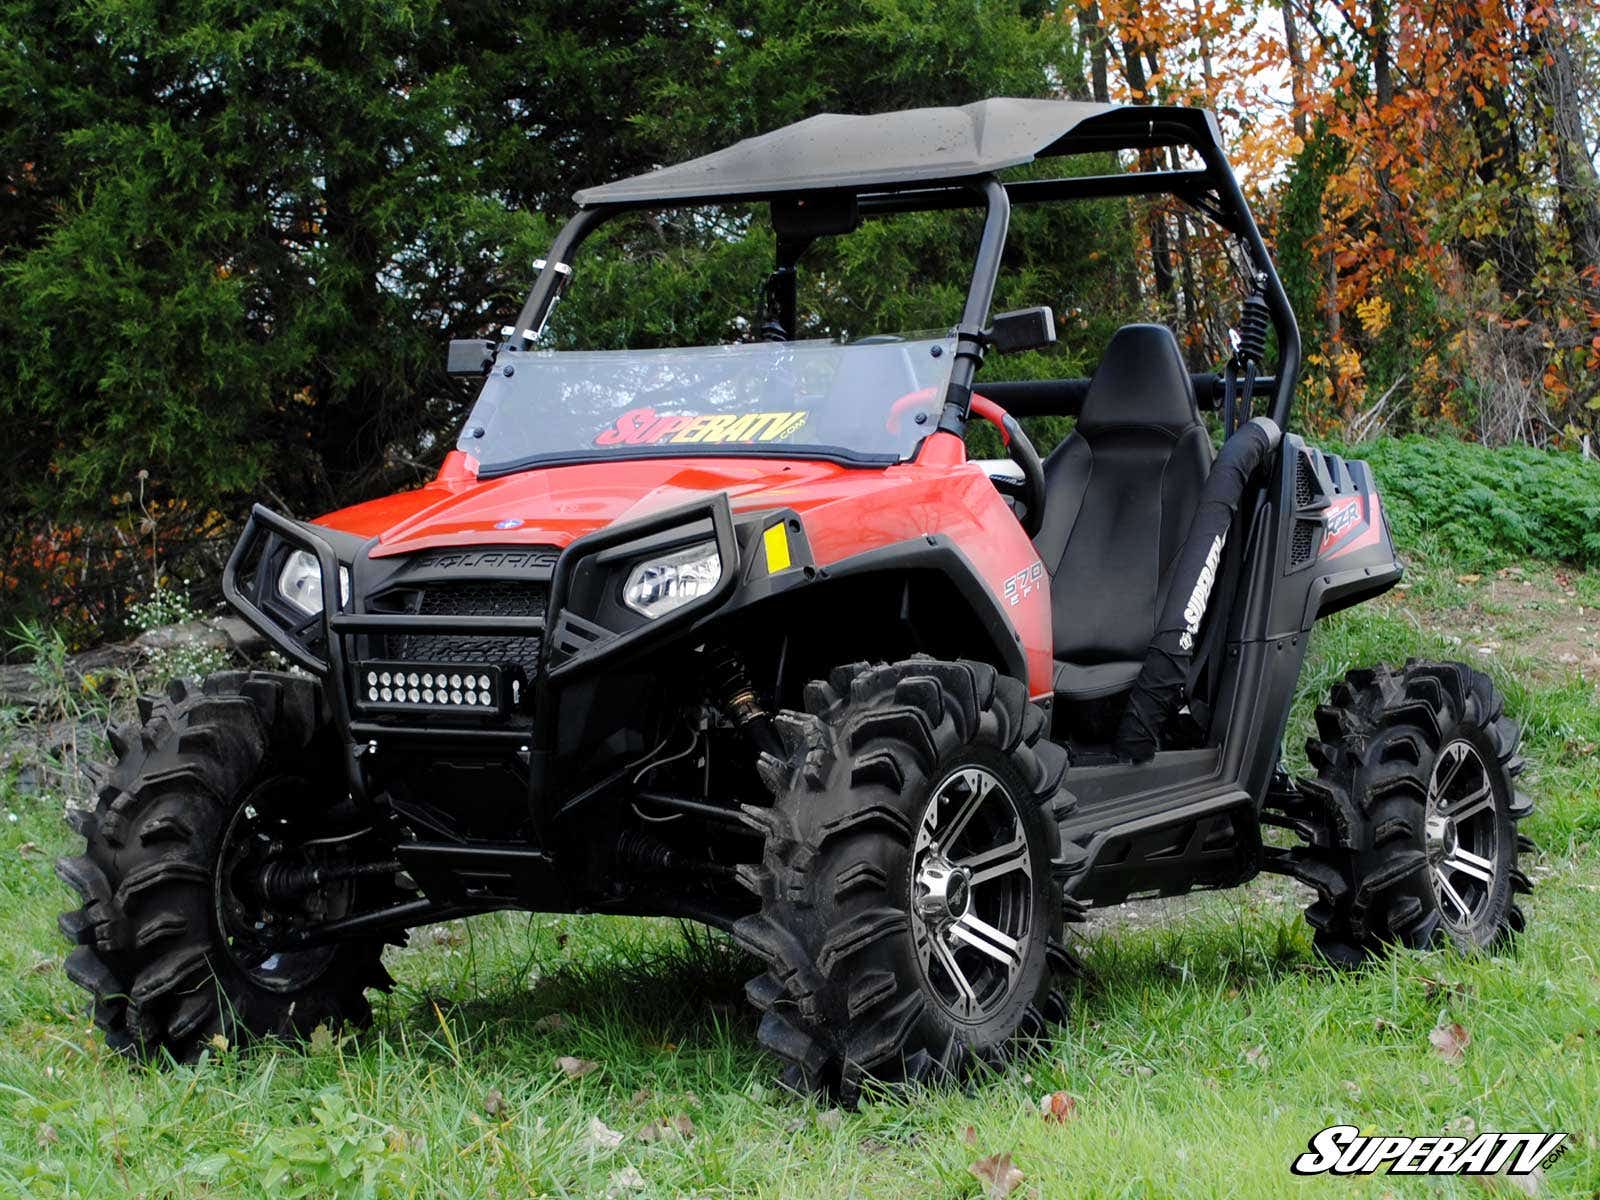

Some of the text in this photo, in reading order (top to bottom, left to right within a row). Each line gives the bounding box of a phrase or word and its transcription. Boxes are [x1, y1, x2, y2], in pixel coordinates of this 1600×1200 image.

[595, 407, 807, 445] SUPERATV
[414, 552, 557, 570] POLARIS
[1003, 560, 1042, 600] 570
[1010, 581, 1040, 606] EFI
